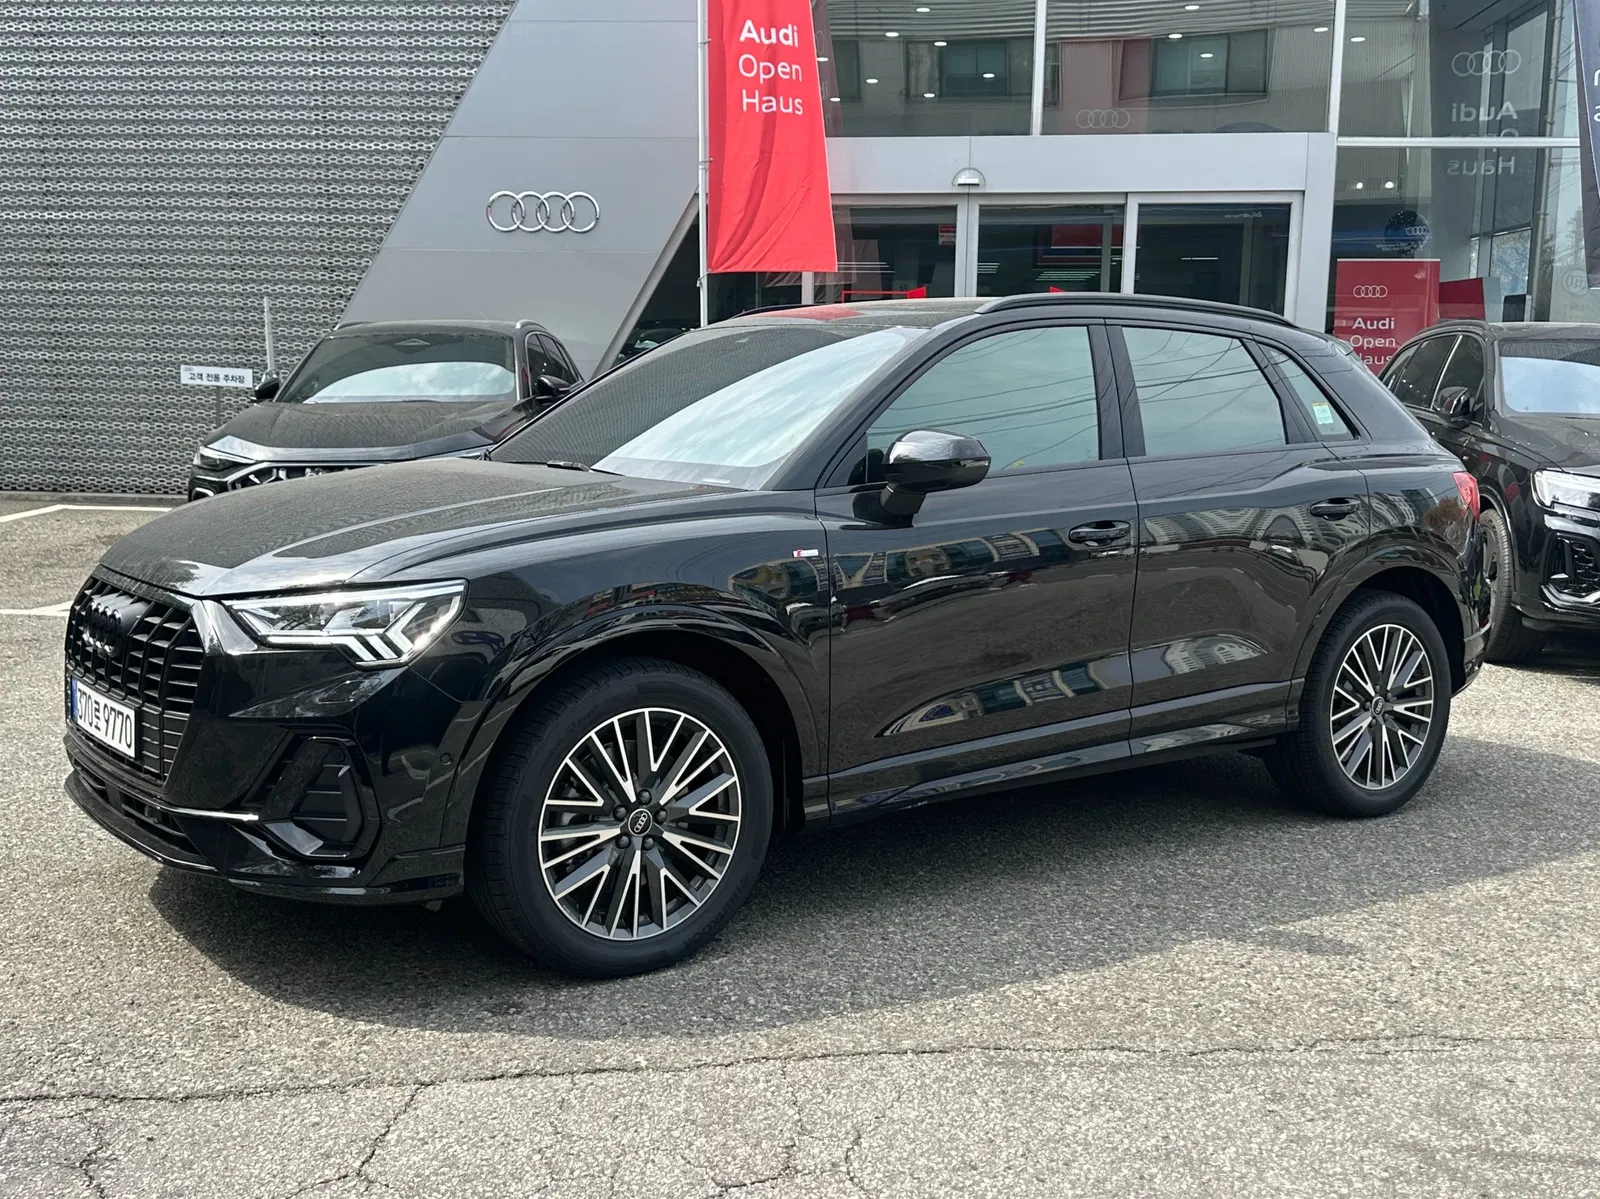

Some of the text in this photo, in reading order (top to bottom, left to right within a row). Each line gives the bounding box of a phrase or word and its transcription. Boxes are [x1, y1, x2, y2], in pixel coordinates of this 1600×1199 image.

[739, 19, 799, 48] Audi
[738, 54, 803, 84] Open
[741, 89, 804, 115] Haus
[1352, 317, 1395, 330] Audi
[1350, 335, 1396, 350] Open
[188, 372, 245, 384] 고객 전용 주차장
[102, 703, 132, 749] 9770
